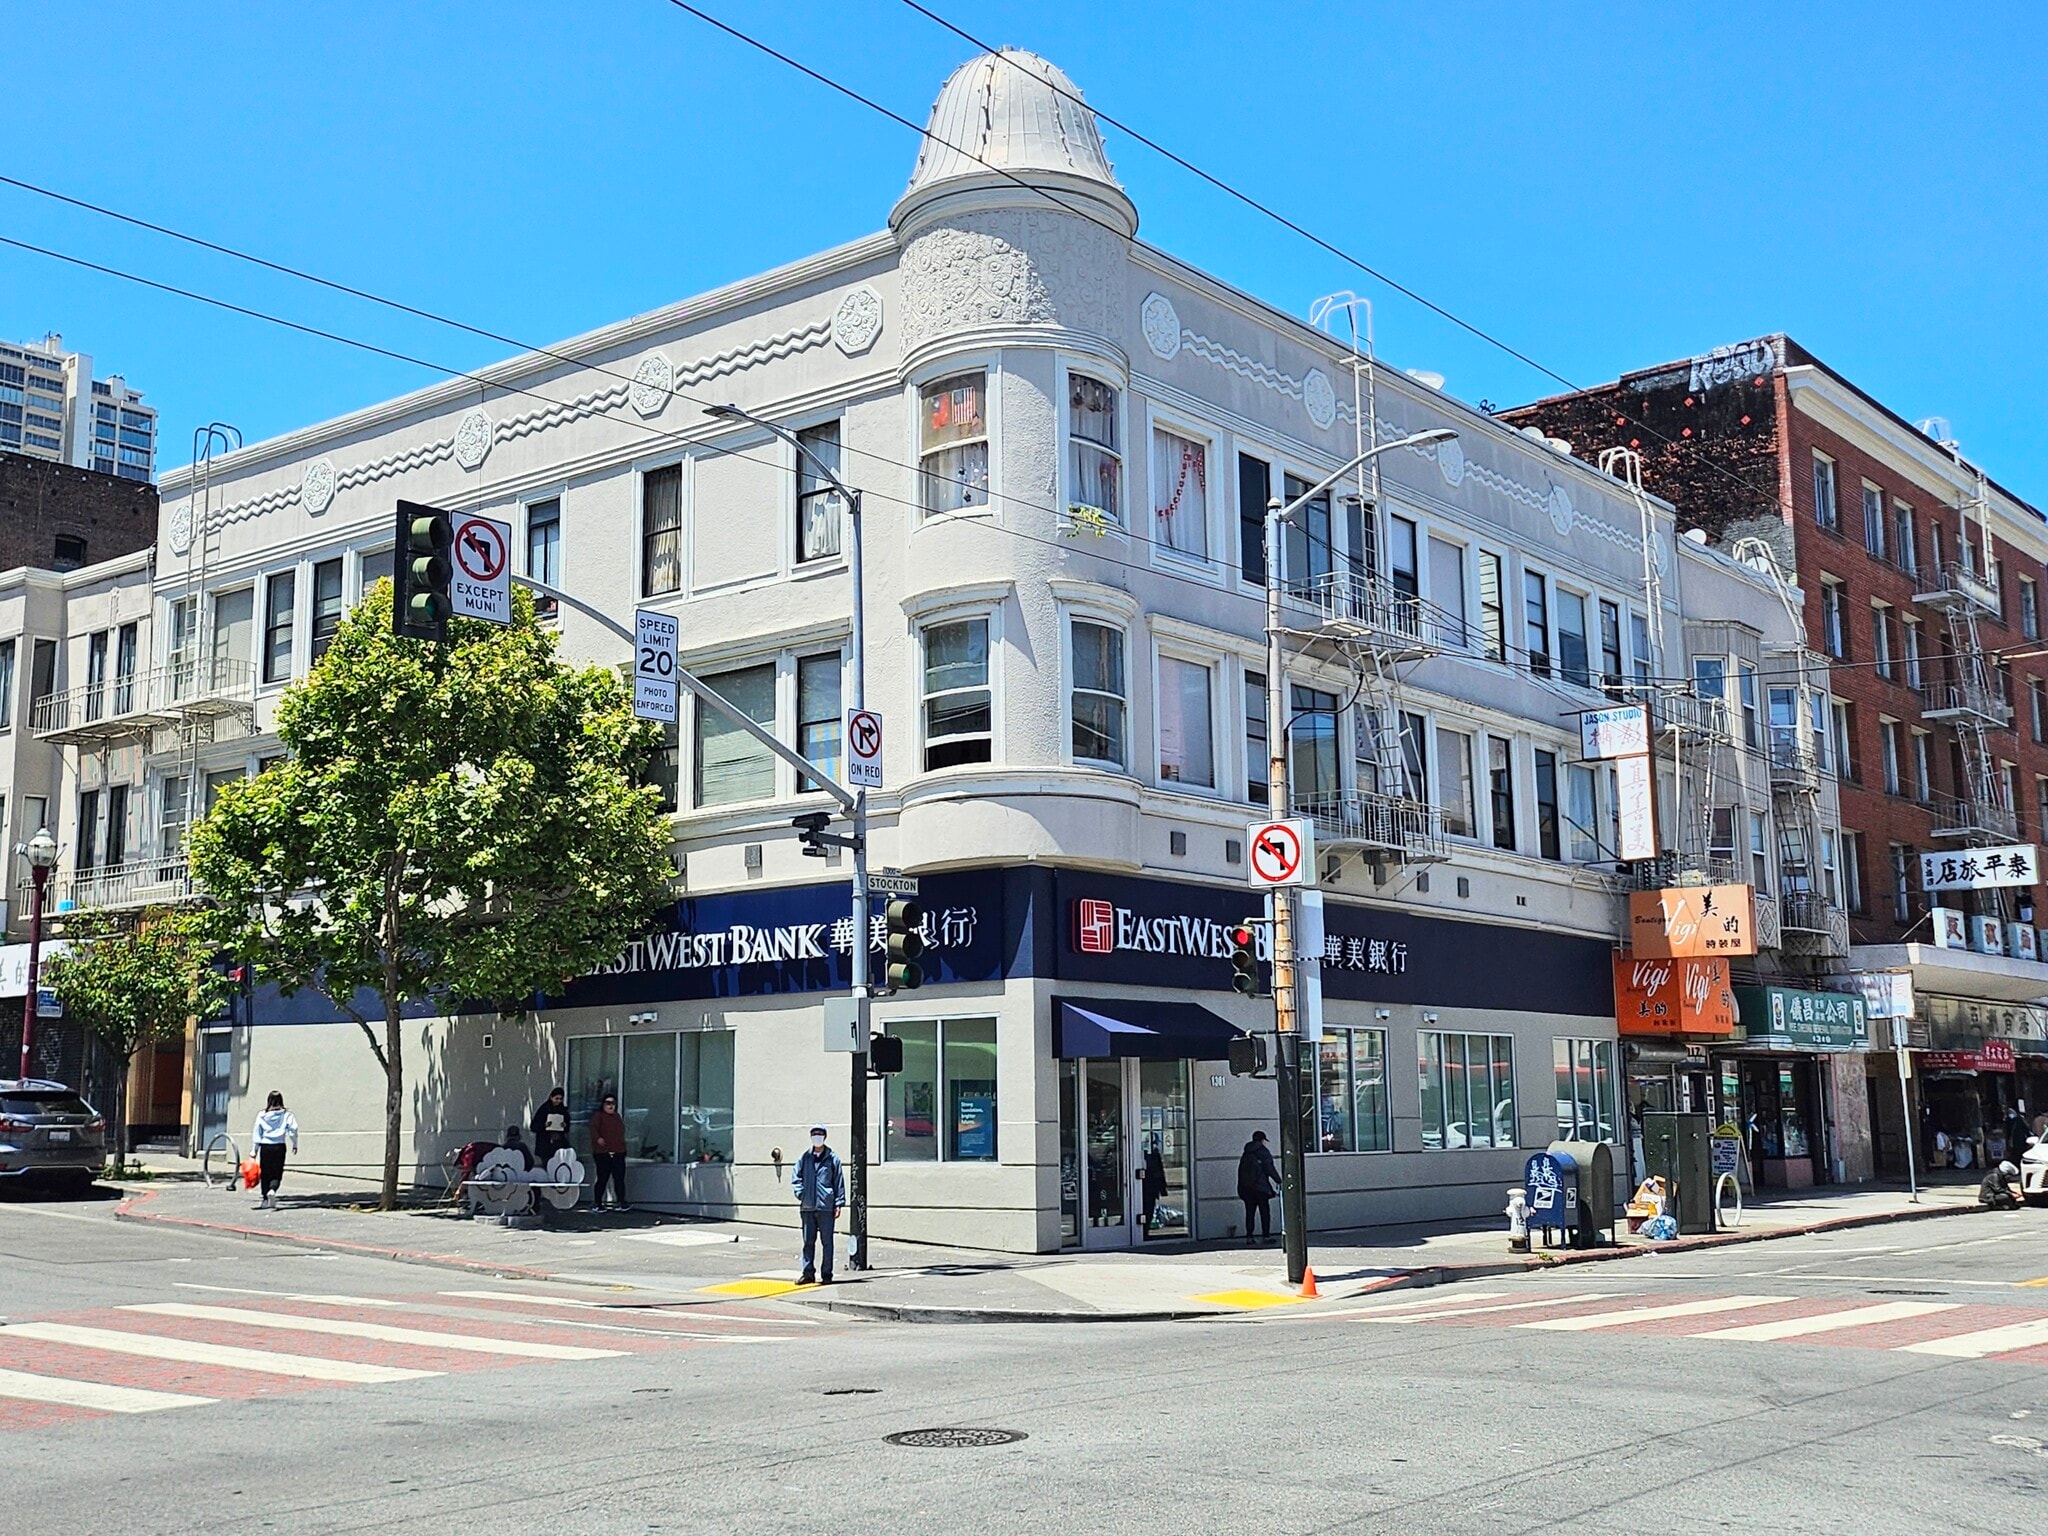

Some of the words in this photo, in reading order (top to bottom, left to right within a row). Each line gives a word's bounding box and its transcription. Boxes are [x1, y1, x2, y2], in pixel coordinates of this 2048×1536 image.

[457, 583, 503, 601] EXCEPT
[465, 597, 496, 613] MUNI
[639, 619, 675, 634] SPEED
[643, 633, 671, 648] LIMIT
[640, 648, 673, 676] 20
[644, 687, 668, 698] PHOTO
[636, 700, 674, 714] ENFORCED
[1584, 712, 1610, 726] JASON
[1612, 709, 1642, 722] STUDIO
[851, 763, 862, 776] ON
[865, 765, 880, 778] RED
[869, 878, 917, 891] STOCKTON
[1657, 898, 1699, 945] Vigi
[1115, 908, 1234, 959] EASTWES
[586, 932, 727, 975] STWEST
[729, 924, 829, 965] BANK
[1324, 935, 1407, 973] 華美銀行
[1632, 960, 1672, 997] Vigi
[1685, 963, 1711, 1015] Vigi
[1210, 1075, 1226, 1087] 1301
